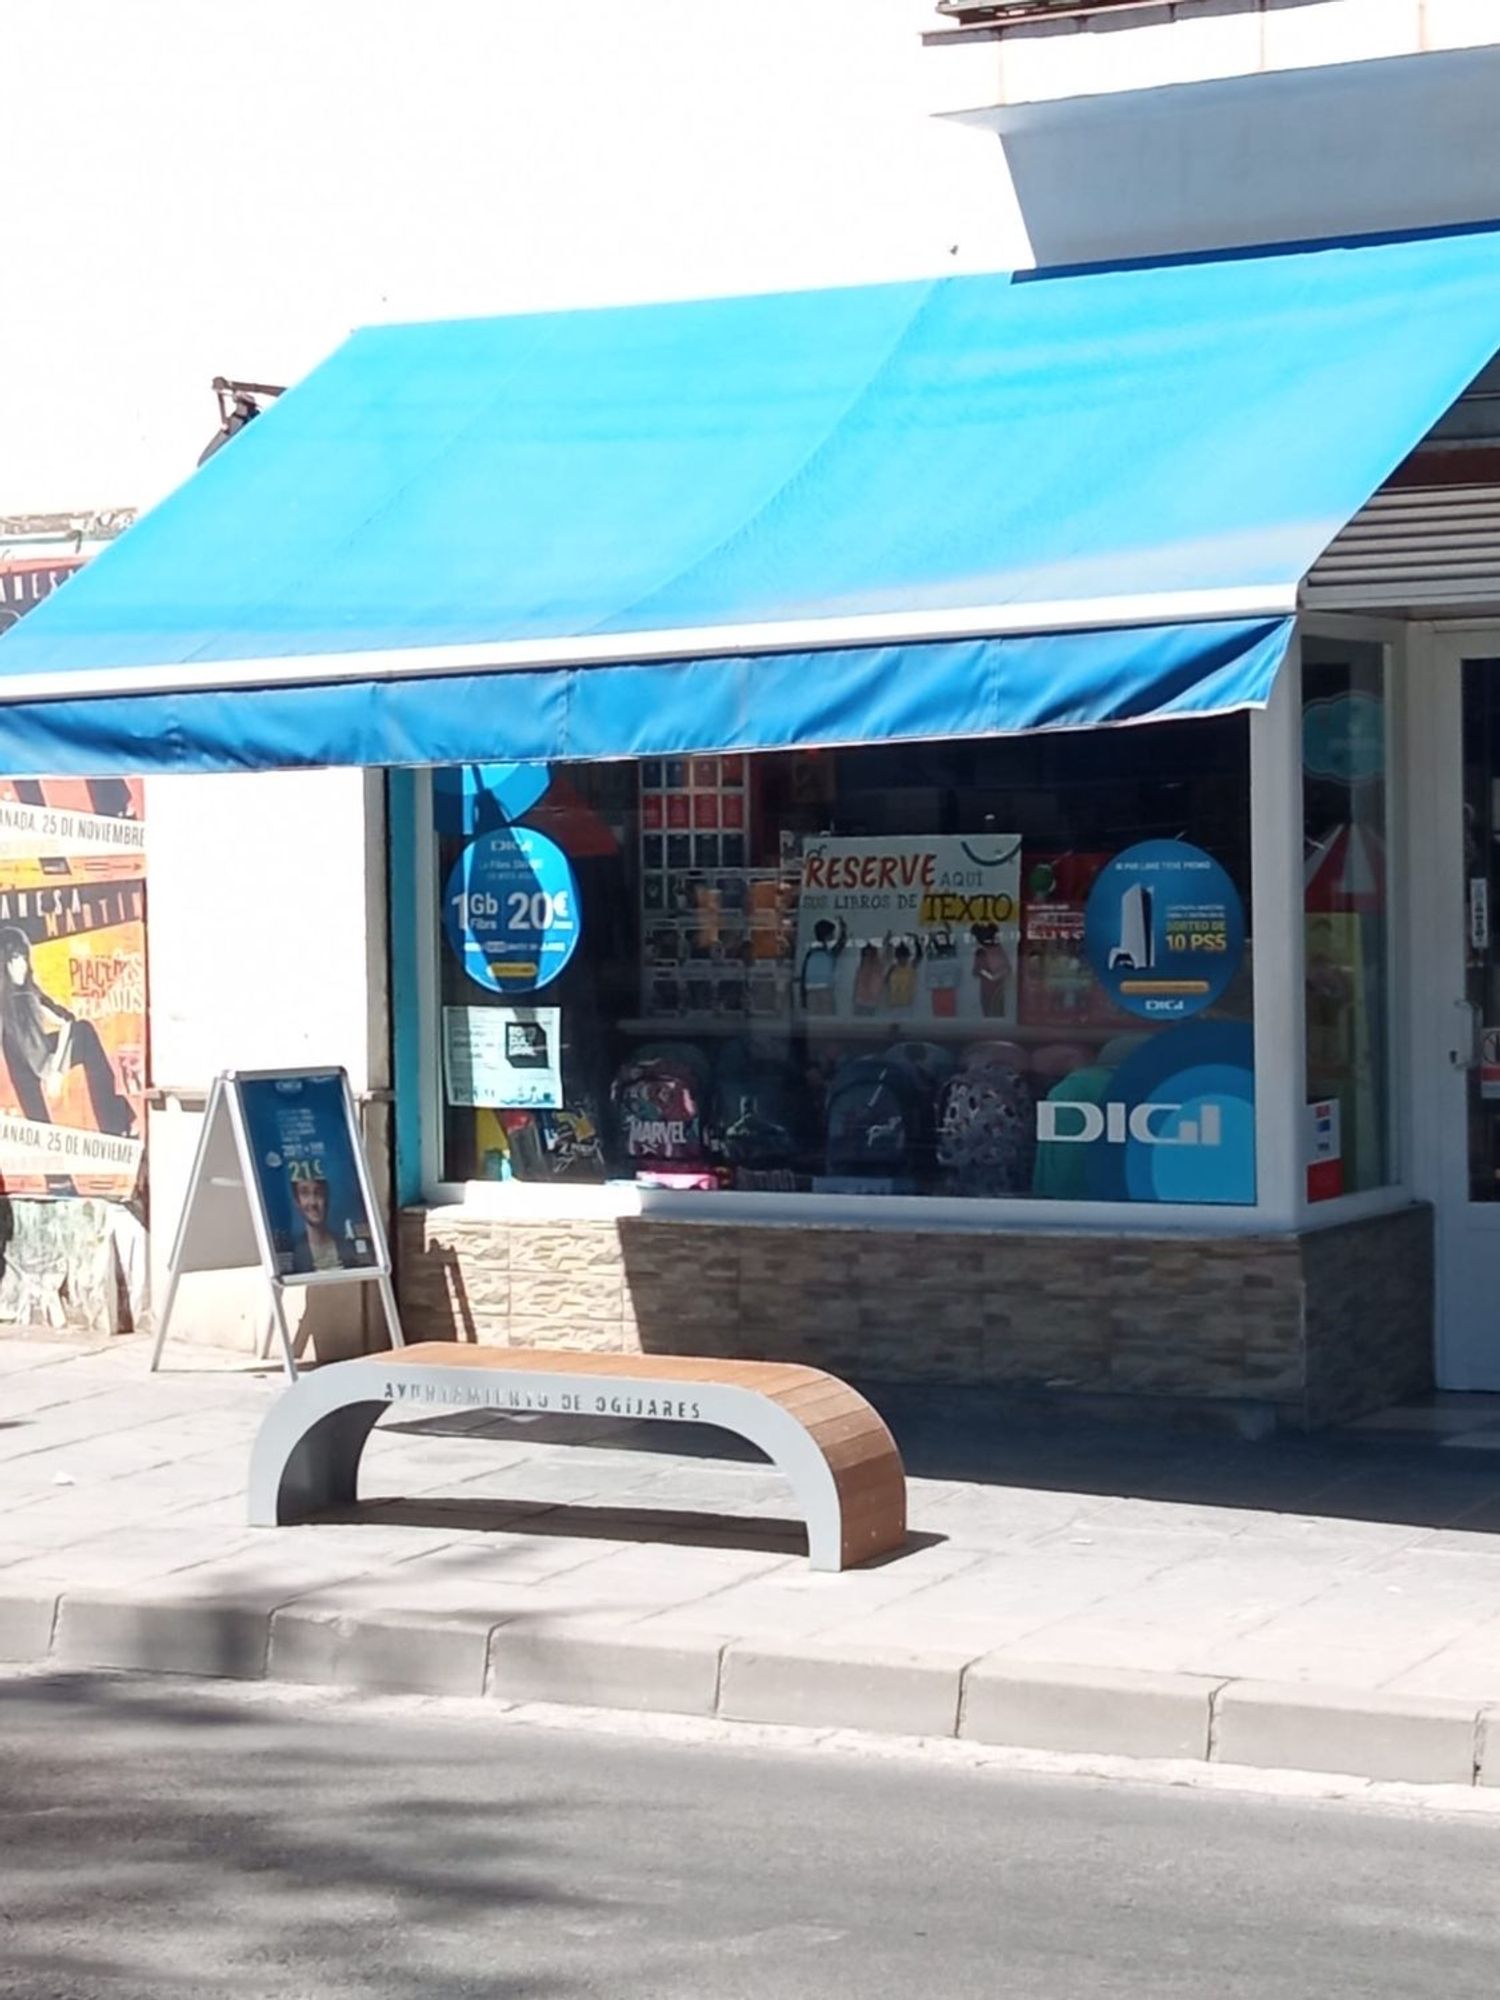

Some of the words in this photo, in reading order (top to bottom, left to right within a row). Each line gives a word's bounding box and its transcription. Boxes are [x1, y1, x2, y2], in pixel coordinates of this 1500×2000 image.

[42, 815, 57, 835] 25
[77, 820, 145, 847] NOVIEMBRE
[805, 853, 938, 889] RESERVE
[470, 892, 499, 914] Gb
[834, 893, 890, 909] LIBROS
[897, 893, 918, 909] DE
[924, 892, 1013, 922] TEXTO
[1166, 934, 1186, 950] 10
[1190, 933, 1227, 950] PS5
[630, 1118, 686, 1157] MARVEL
[1037, 1101, 1221, 1145] DIGI
[47, 1132, 61, 1151] 25
[65, 1134, 79, 1155] DE
[384, 1382, 550, 1409] AYUNTAMIENTO
[561, 1394, 581, 1412] DE
